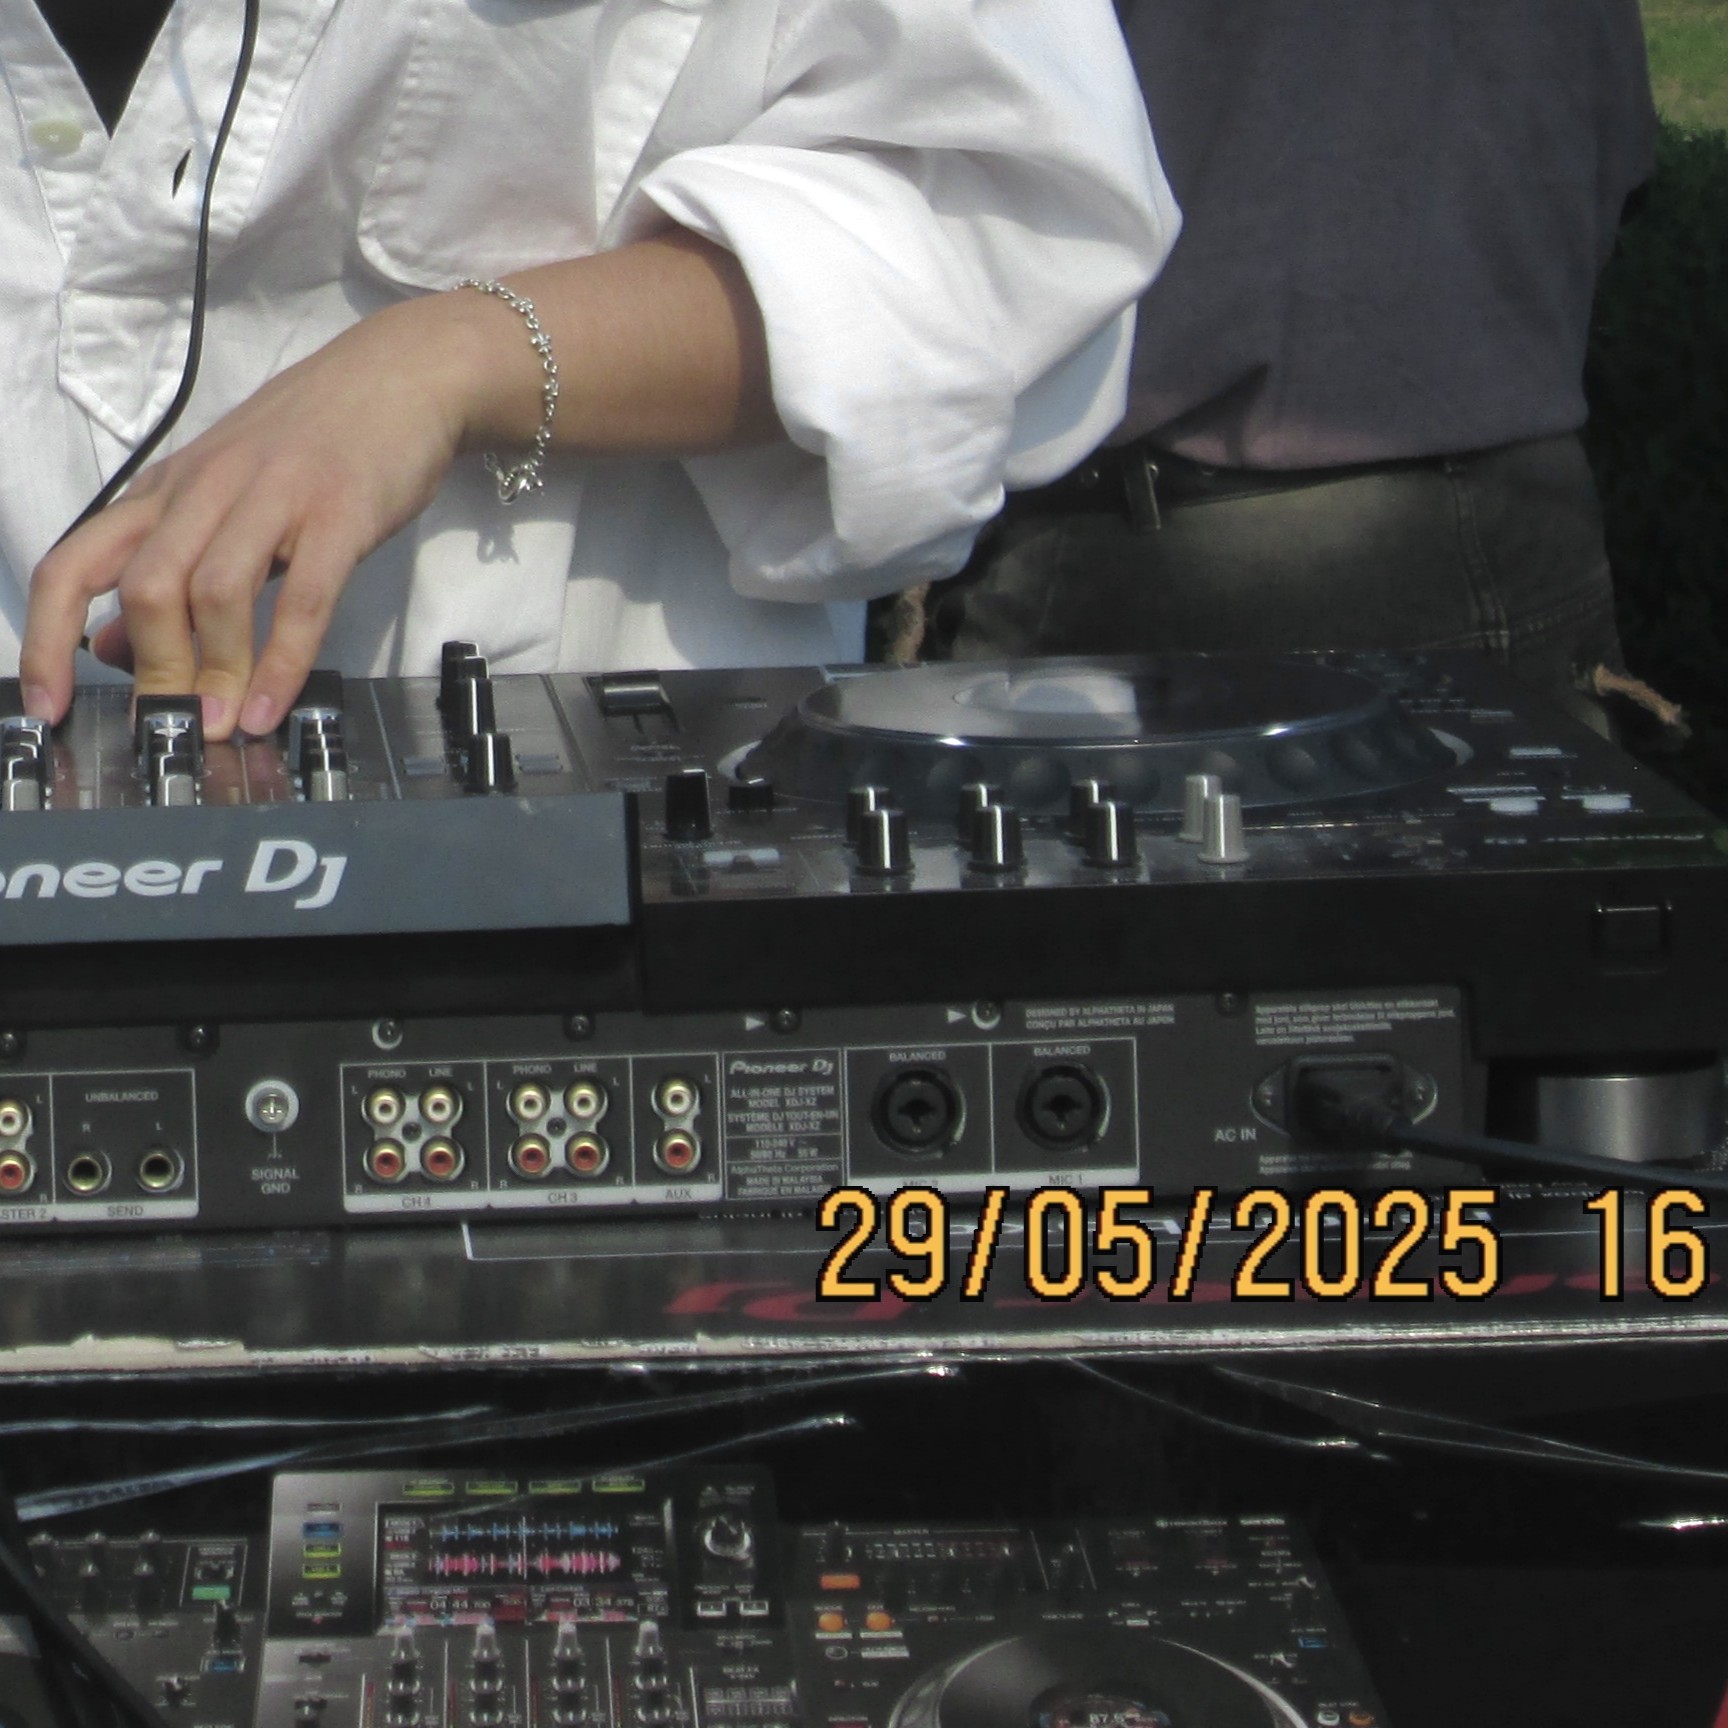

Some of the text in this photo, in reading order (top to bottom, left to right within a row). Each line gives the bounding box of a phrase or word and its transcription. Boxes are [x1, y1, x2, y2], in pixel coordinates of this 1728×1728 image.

[889, 1051, 946, 1062] BALANCED
[1033, 1045, 1091, 1057] BALANCED
[368, 1067, 453, 1079] PHONO LINE
[513, 1063, 597, 1075] PHONO LINE
[729, 1060, 809, 1075] Pioneer
[85, 1091, 159, 1103] UNBALANCED
[1214, 1127, 1257, 1142] AC IN
[251, 1168, 300, 1181] SIGNAL
[260, 1183, 292, 1195] GND
[665, 1187, 693, 1200] AUX
[548, 1191, 578, 1204] CH 3
[37, 1207, 47, 1220] 2
[107, 1204, 144, 1218] SEND
